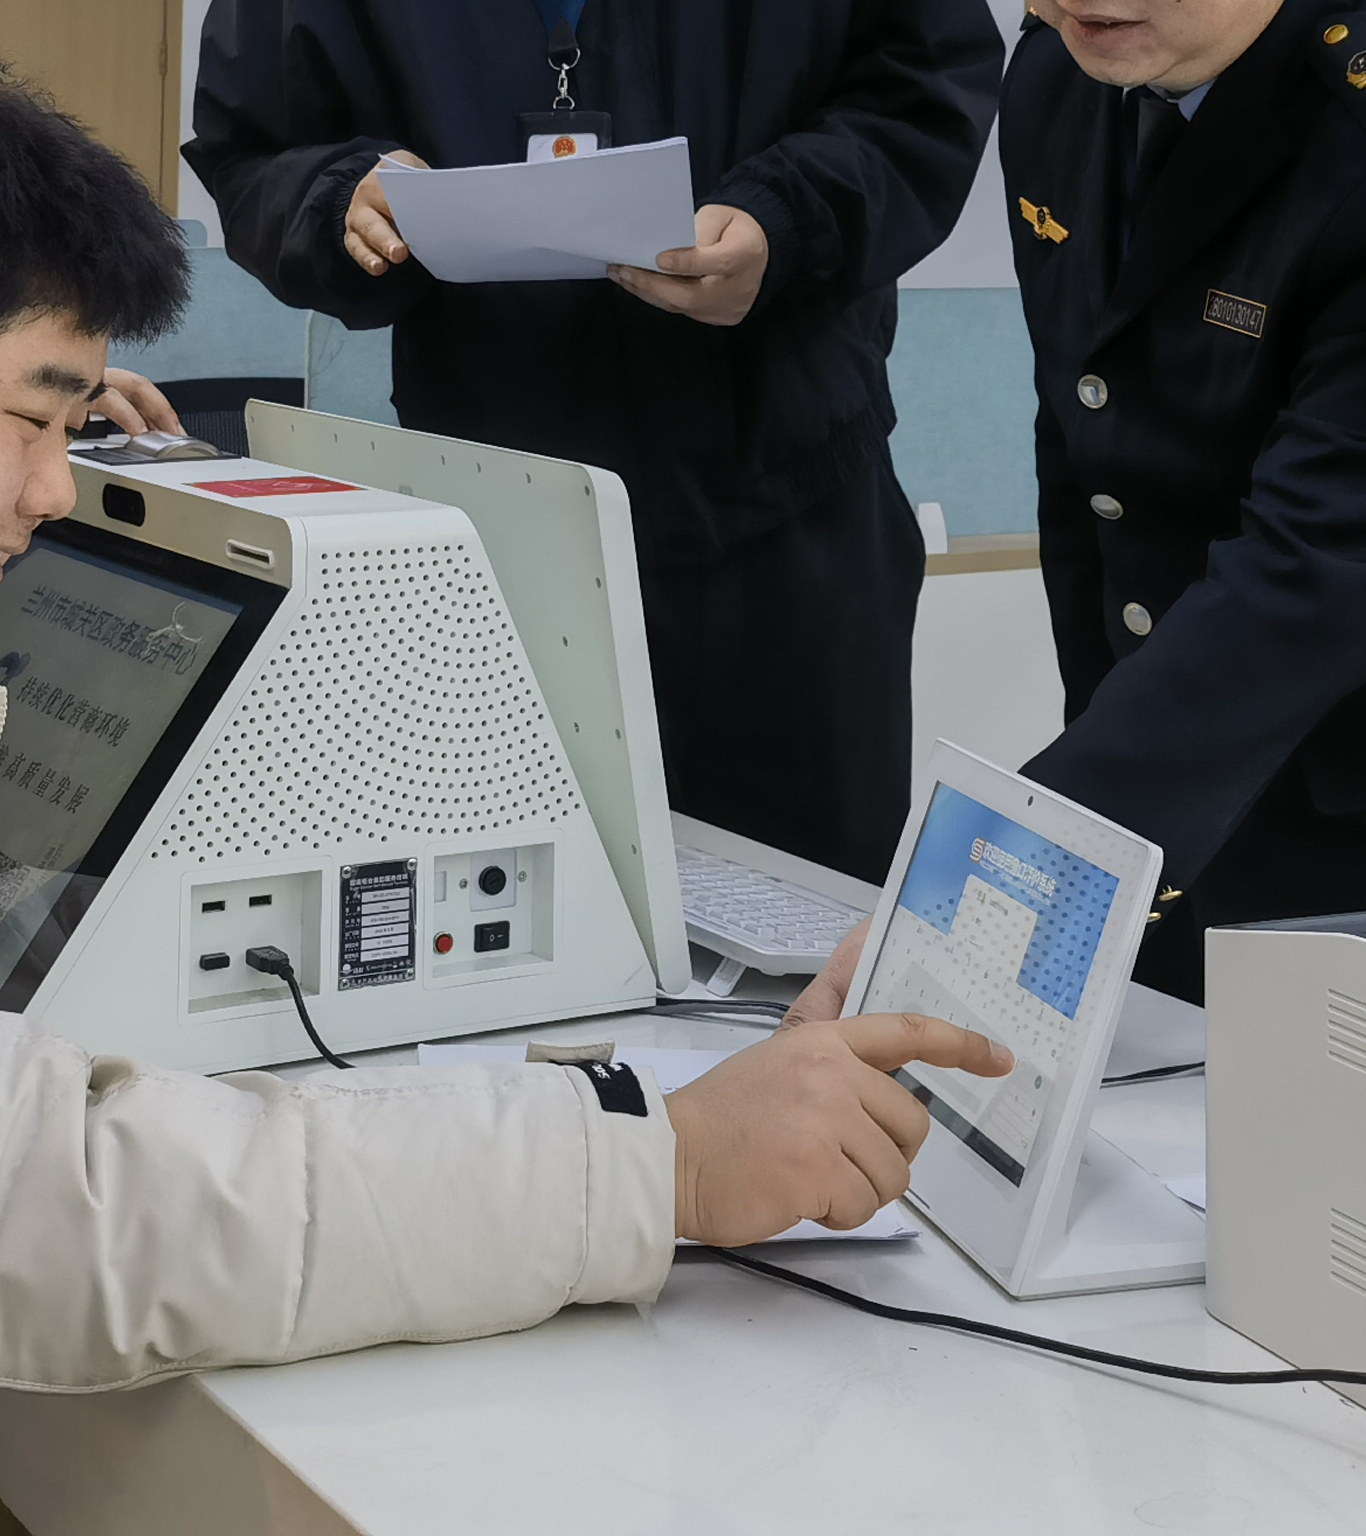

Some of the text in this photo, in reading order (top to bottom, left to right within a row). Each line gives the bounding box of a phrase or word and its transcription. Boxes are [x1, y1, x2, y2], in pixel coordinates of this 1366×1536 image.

[16, 676, 131, 747] 持续优化营商环境
